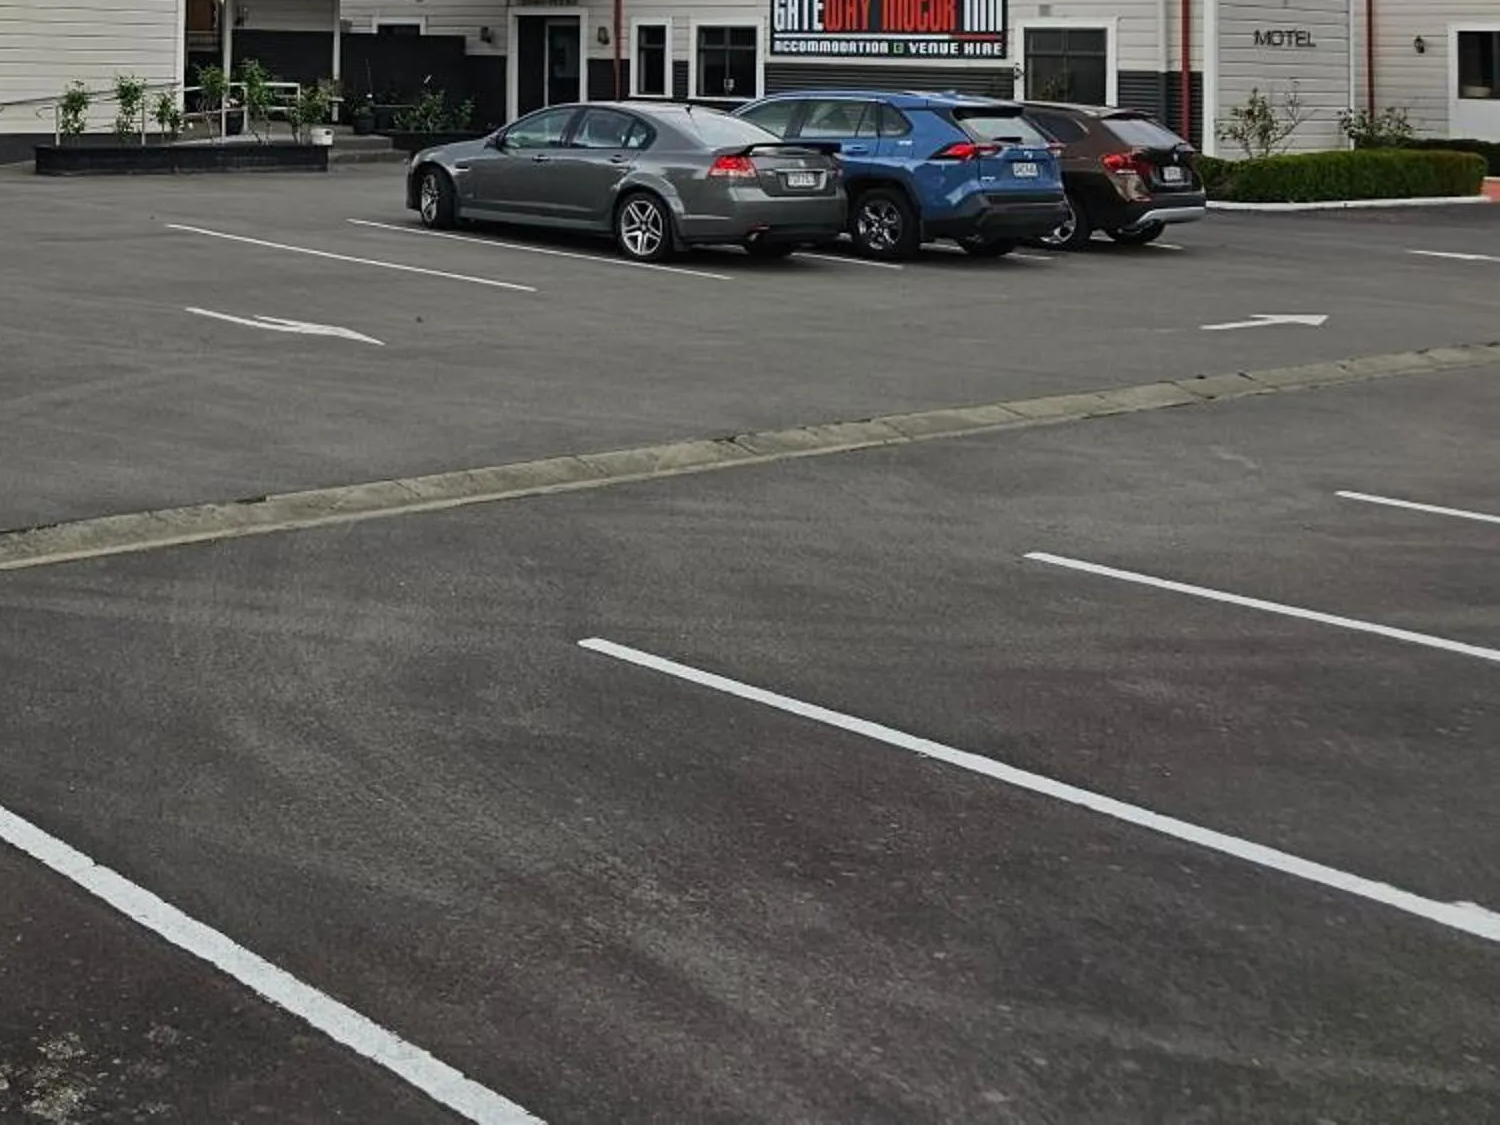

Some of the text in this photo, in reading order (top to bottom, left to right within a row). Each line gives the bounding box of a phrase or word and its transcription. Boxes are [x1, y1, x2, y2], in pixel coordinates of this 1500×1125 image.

[1253, 29, 1317, 48] MOTEL
[773, 40, 889, 54] ACCOMMODATION
[908, 41, 959, 56] VENUE
[963, 42, 1003, 57] HIRE
